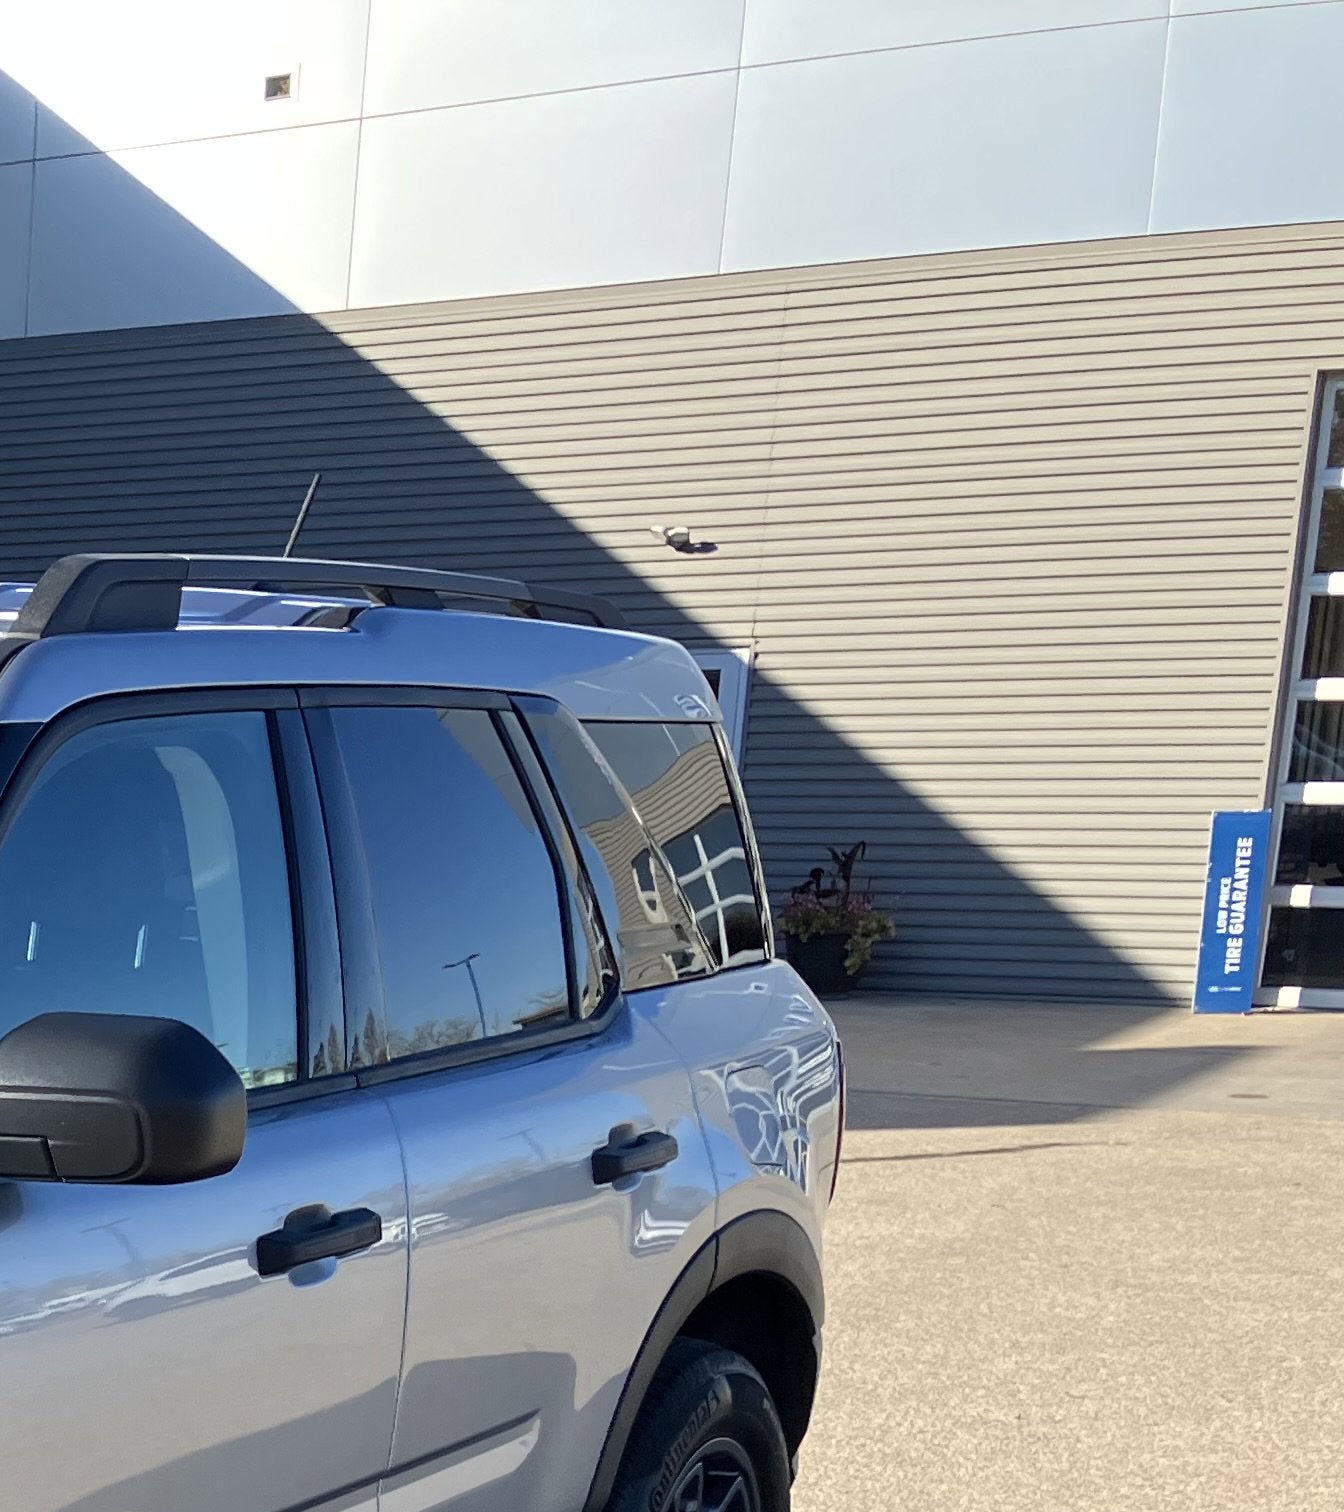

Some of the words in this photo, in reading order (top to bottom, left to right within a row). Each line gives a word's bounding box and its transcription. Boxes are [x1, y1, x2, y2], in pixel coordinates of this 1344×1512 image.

[1218, 876, 1232, 909] PRICE
[1228, 837, 1253, 935] GUARANTEE
[1216, 909, 1228, 934] LOW
[1224, 937, 1243, 975] TIRE
